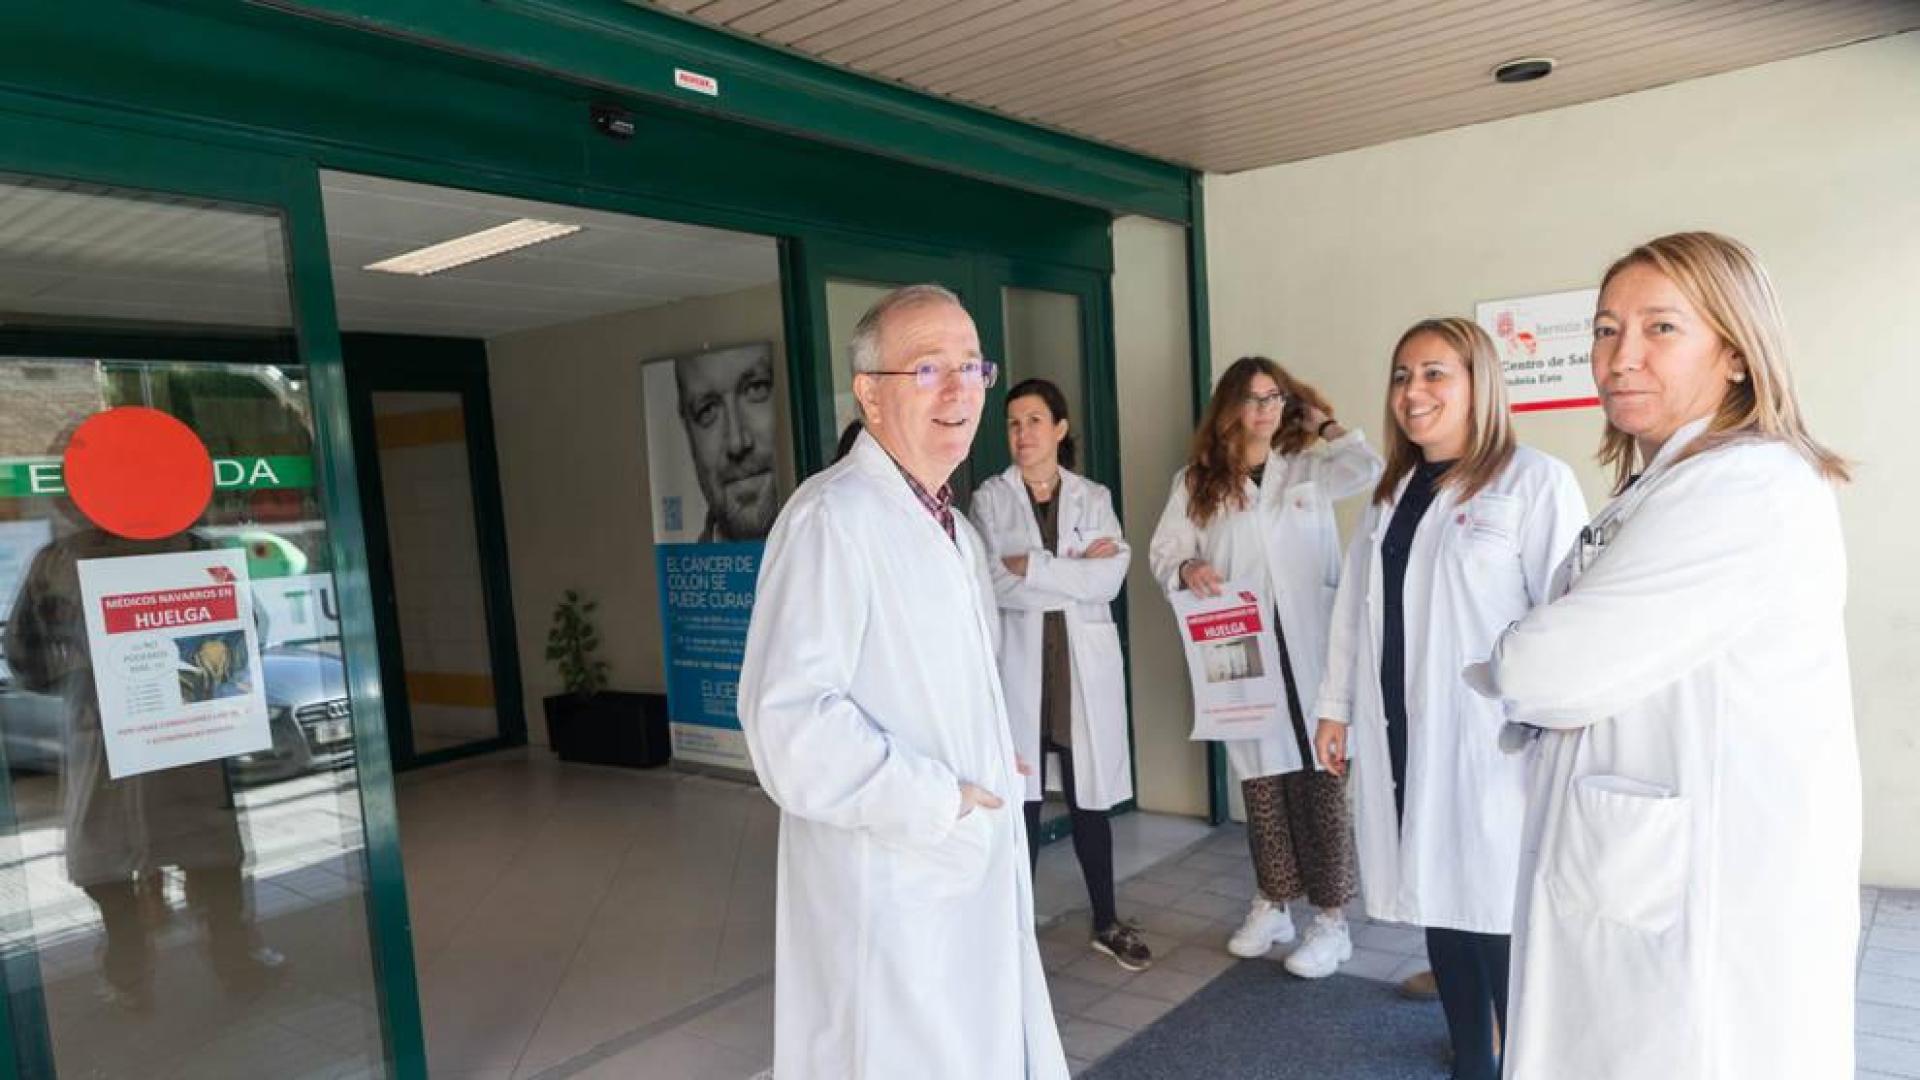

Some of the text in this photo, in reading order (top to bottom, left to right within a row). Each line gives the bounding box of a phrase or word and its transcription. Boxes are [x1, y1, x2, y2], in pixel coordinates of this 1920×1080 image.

[1503, 352, 1589, 372] Centro de Sal
[1505, 376, 1536, 385] udela
[667, 556, 681, 573] EL
[734, 555, 754, 573] DE
[711, 573, 728, 591] SE
[158, 589, 217, 603] NAVARROS
[668, 590, 708, 609] PUEDE
[134, 606, 212, 629] HUELGA
[1205, 622, 1246, 637] HUELGA
